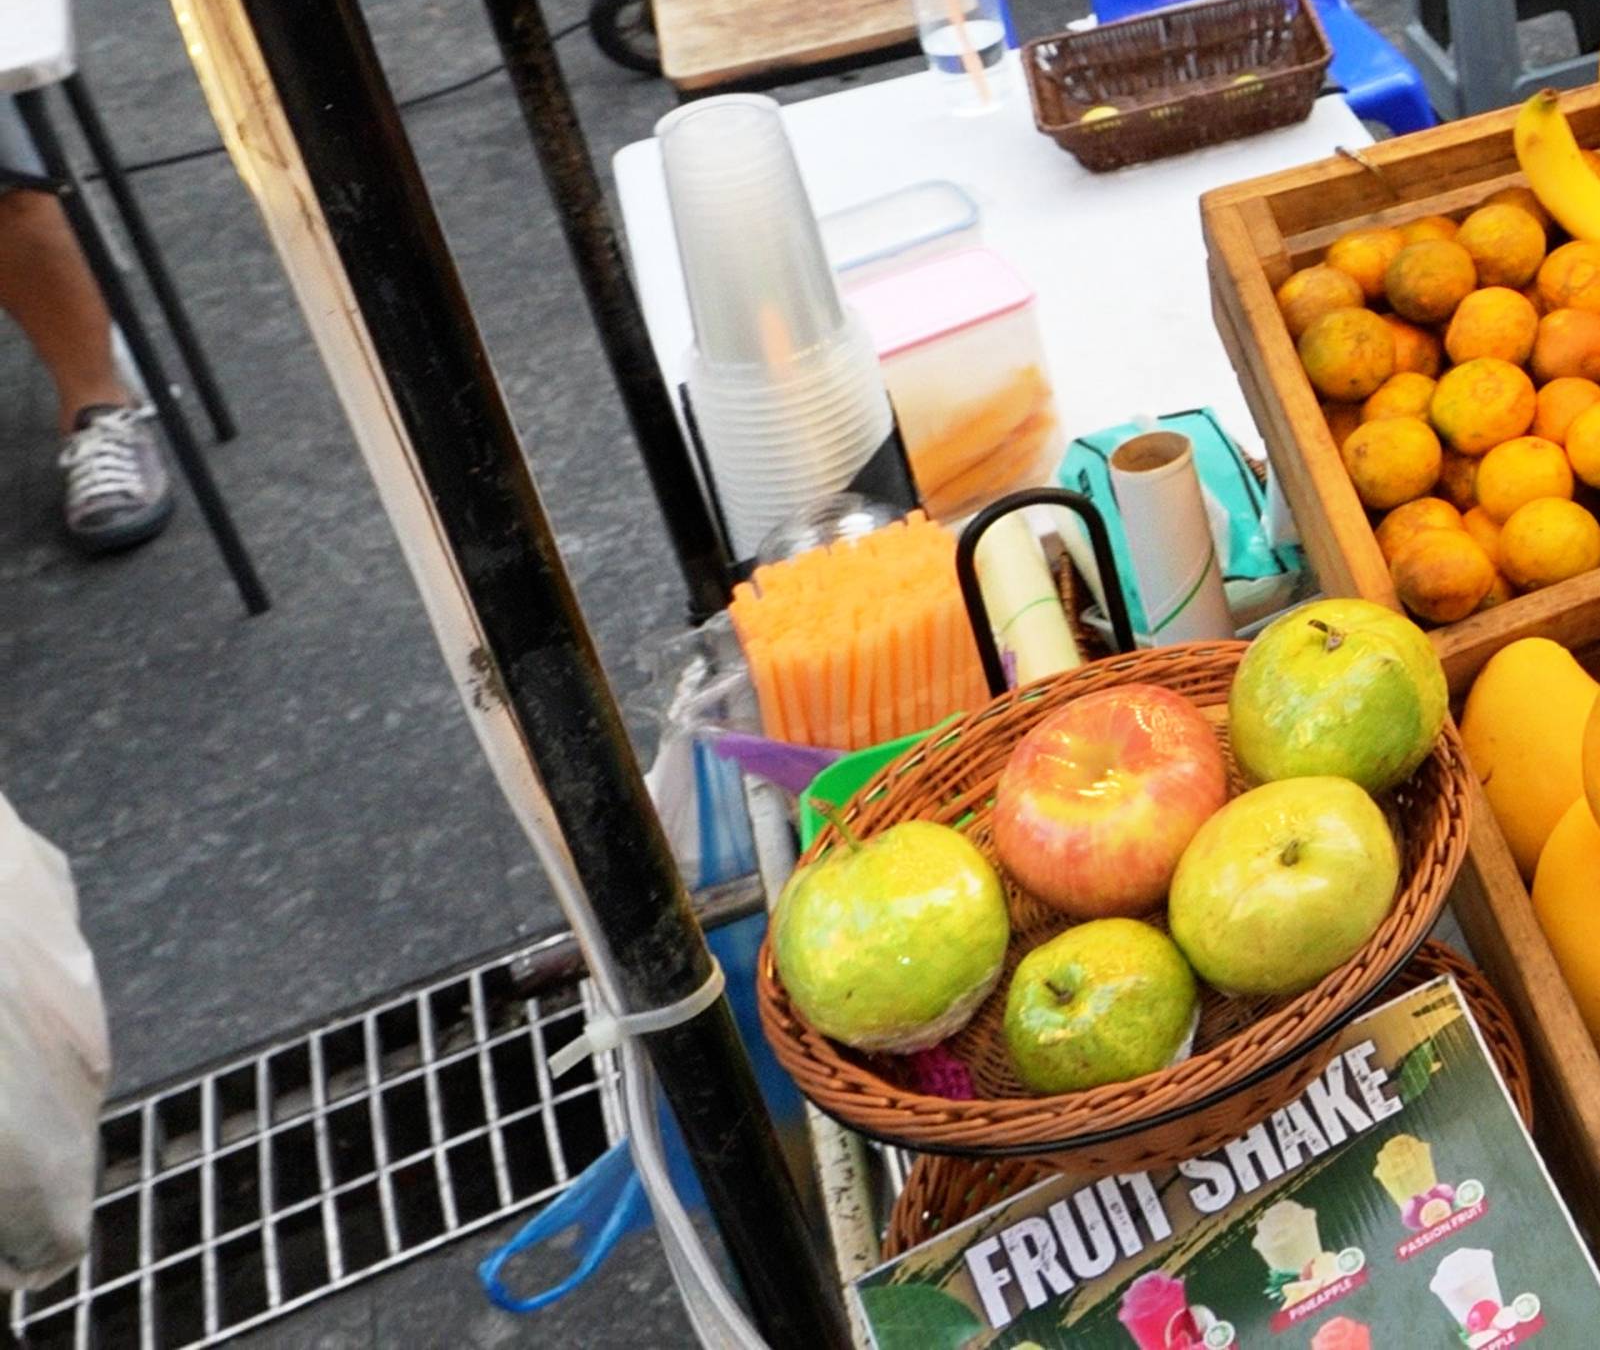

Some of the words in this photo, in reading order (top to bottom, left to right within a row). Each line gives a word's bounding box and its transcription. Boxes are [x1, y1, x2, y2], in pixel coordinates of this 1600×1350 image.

[964, 1170, 1173, 1329] FRUIT
[1178, 1039, 1404, 1214] SHAKE
[1399, 1220, 1453, 1256] PASSION
[1451, 1202, 1483, 1229] FRUIT
[1288, 1278, 1354, 1321] PINEAPPLE
